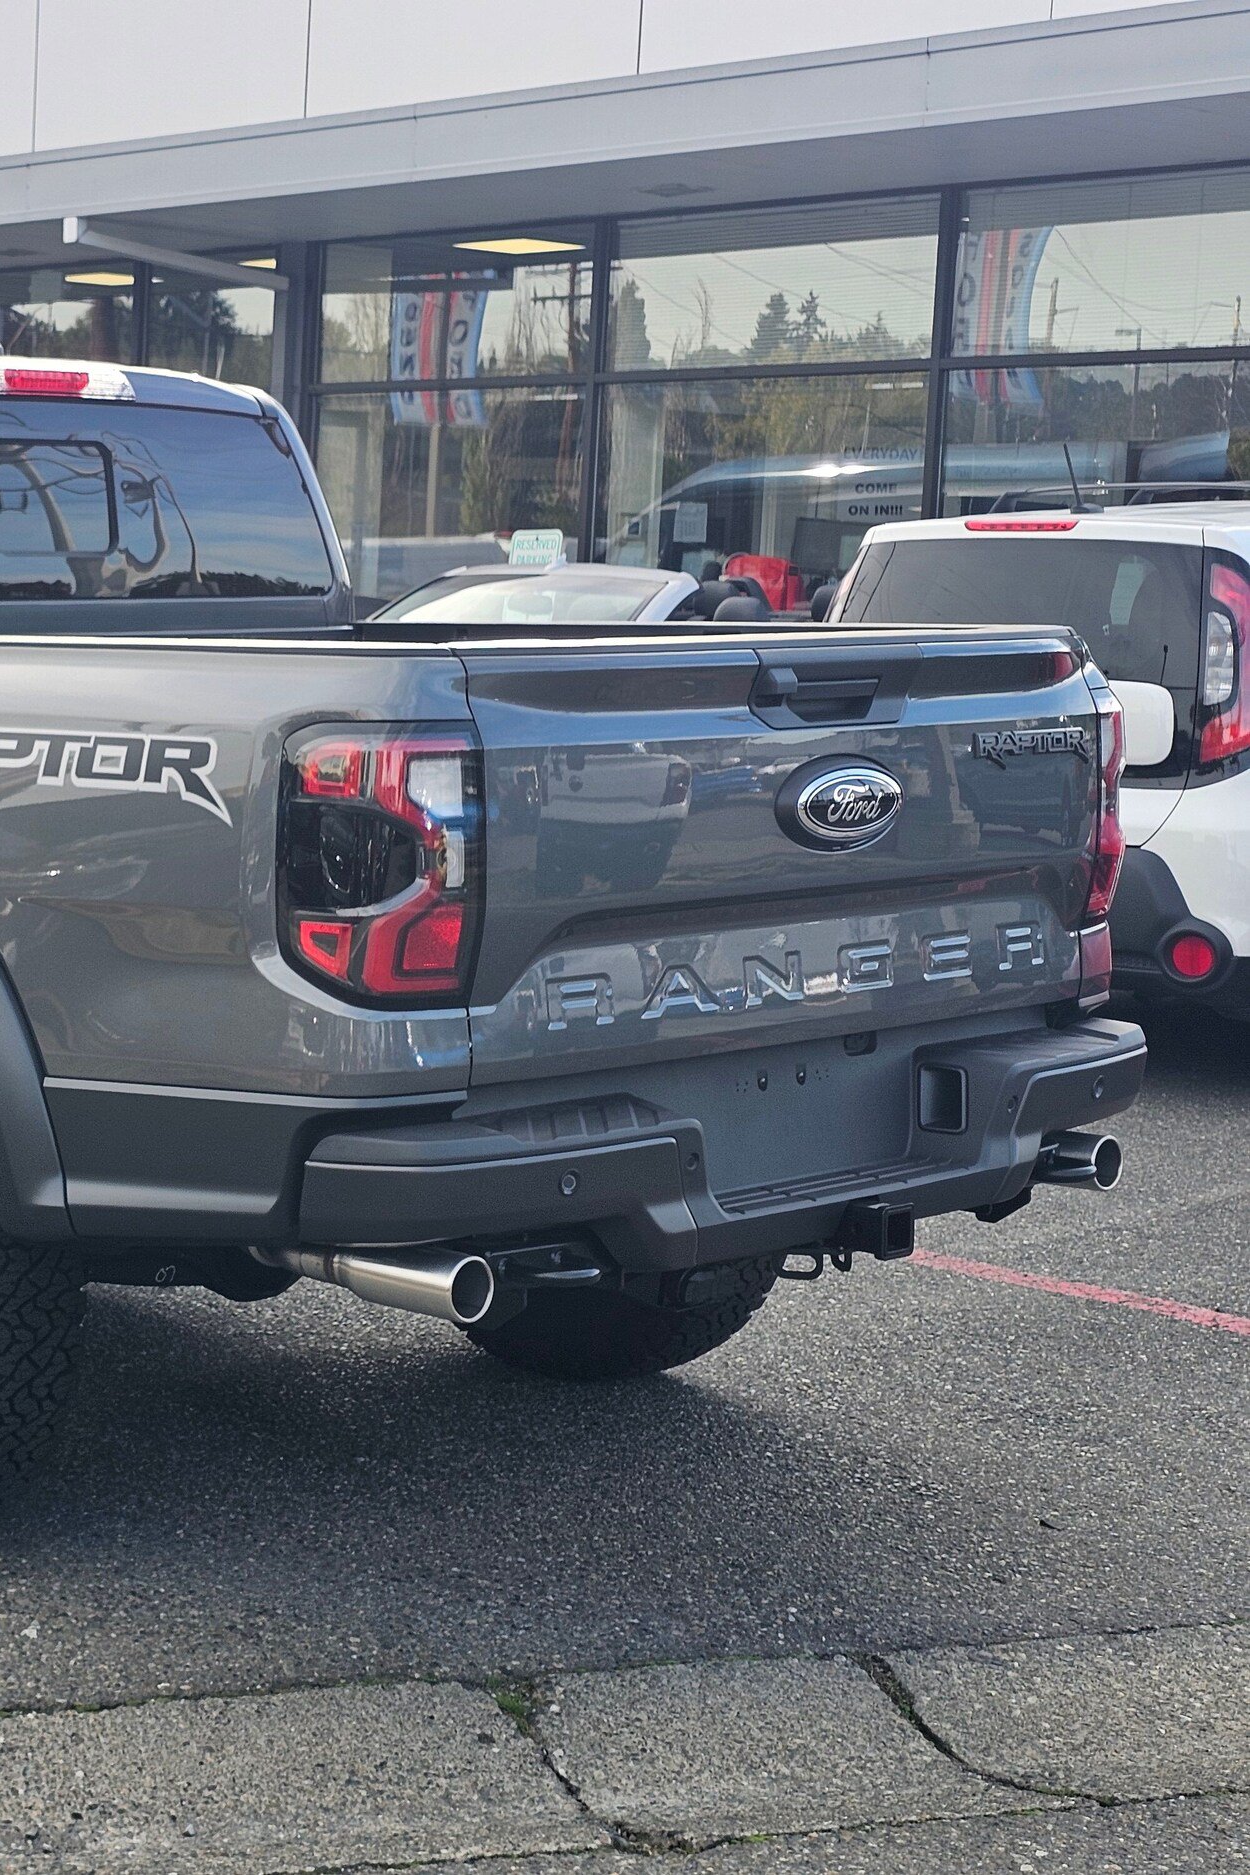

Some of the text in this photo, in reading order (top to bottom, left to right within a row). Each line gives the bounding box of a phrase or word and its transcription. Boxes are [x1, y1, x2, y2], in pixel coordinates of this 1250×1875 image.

[843, 446, 918, 461] EVERYDAY
[854, 482, 898, 494] COME
[848, 504, 904, 516] ON IN!!!
[516, 539, 558, 550] RESERVED
[973, 726, 1090, 770] RAPTOR
[826, 783, 882, 823] Ford
[543, 920, 1046, 1032] RANGER
